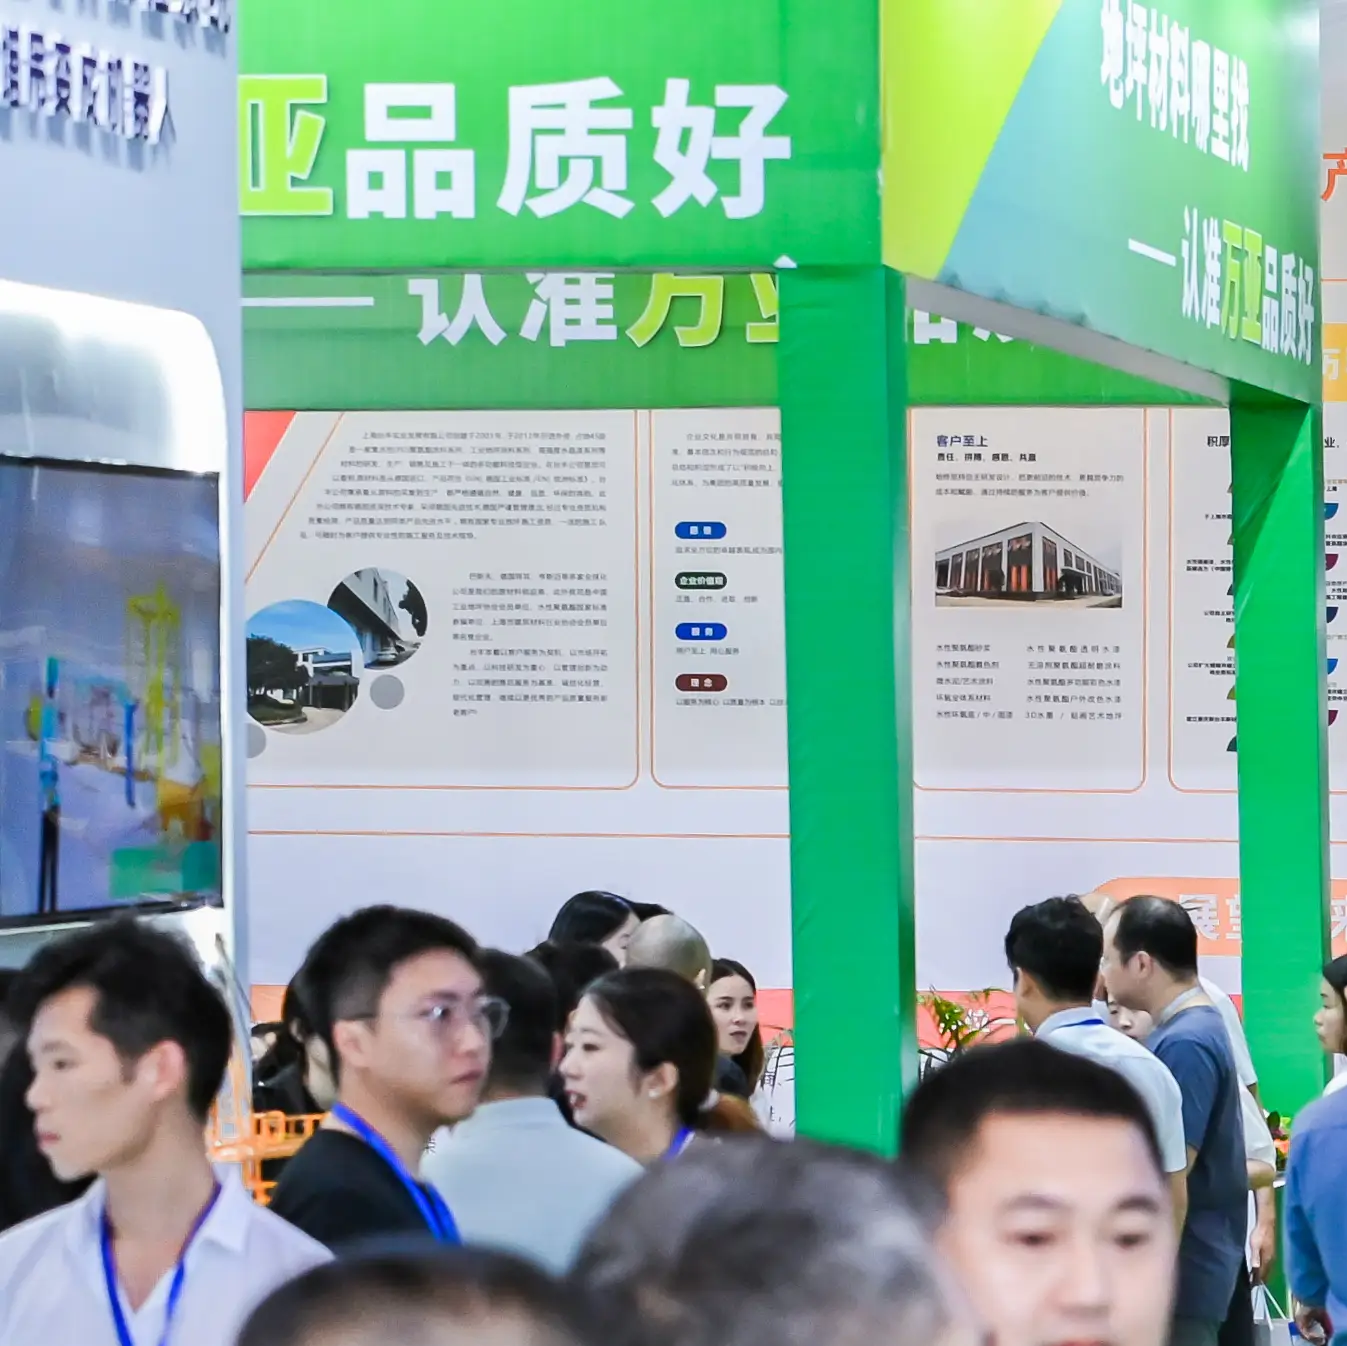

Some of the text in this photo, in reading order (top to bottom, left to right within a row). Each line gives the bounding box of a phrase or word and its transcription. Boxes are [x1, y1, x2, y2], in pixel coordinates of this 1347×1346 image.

[1099, 2, 1250, 172] 地坪材料哪里找
[936, 434, 988, 447] 客户至上
